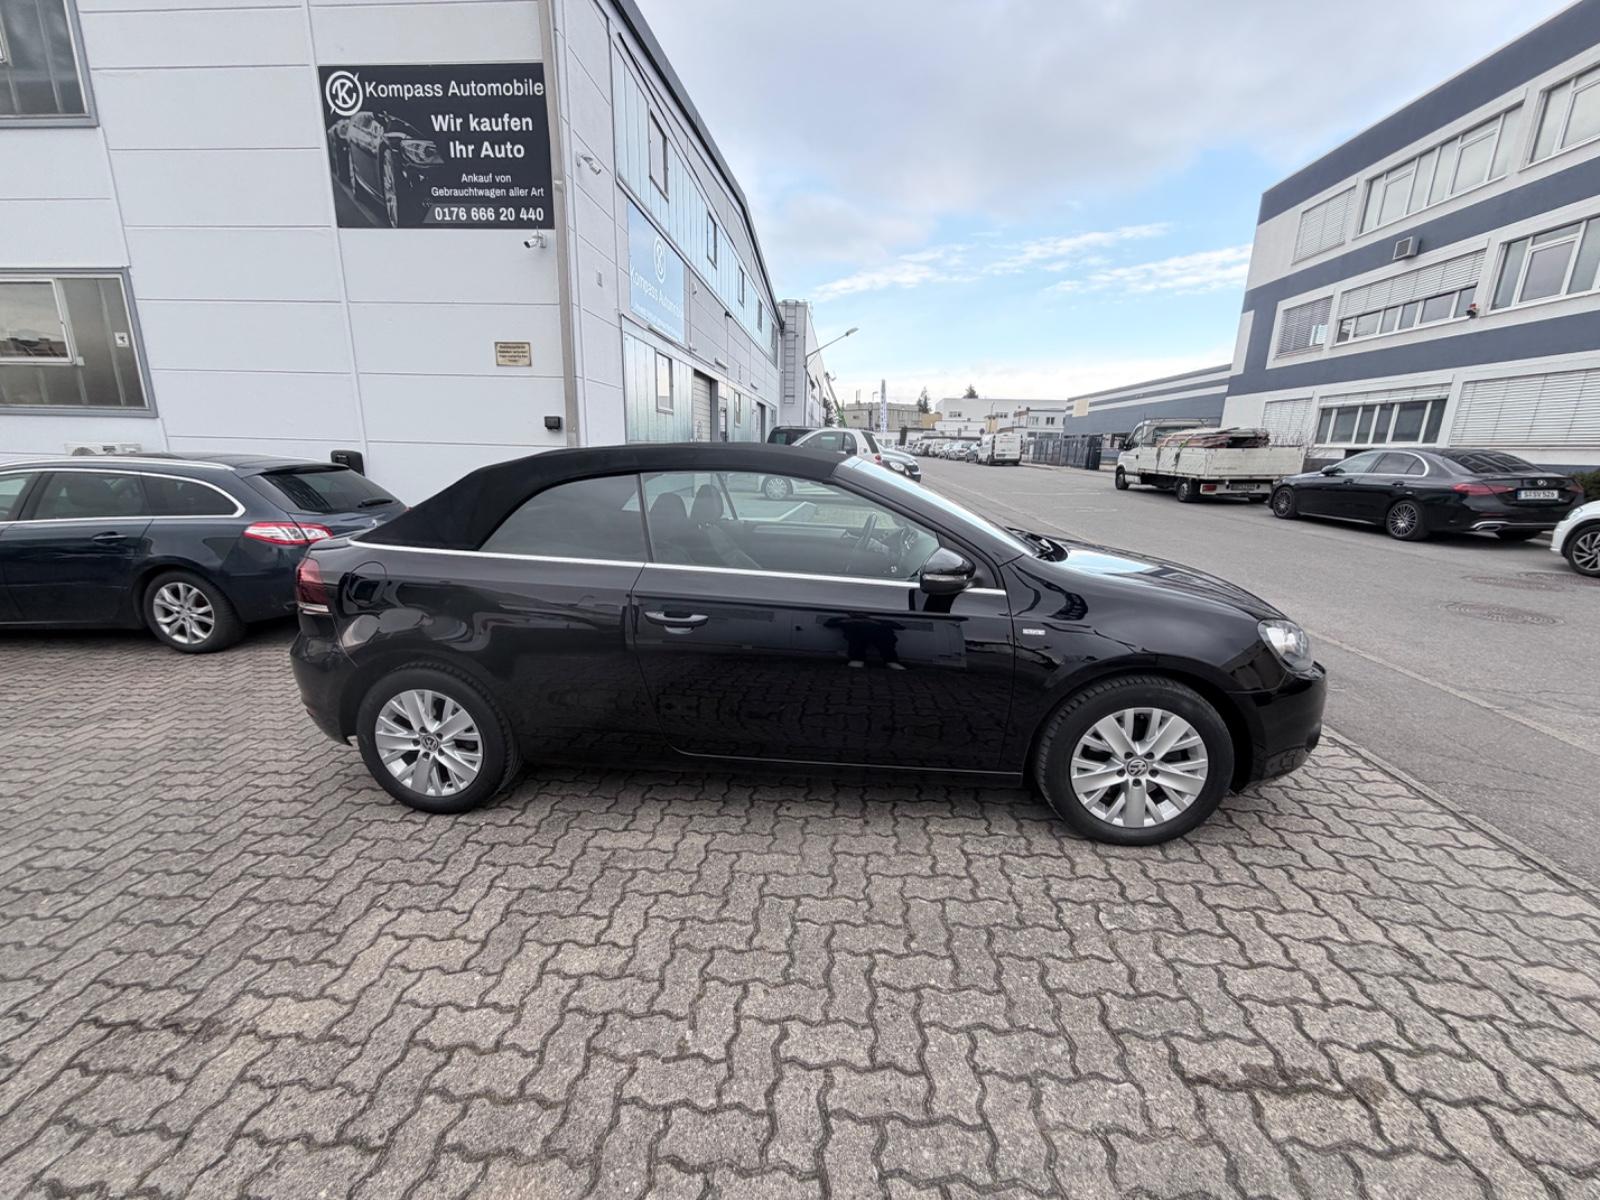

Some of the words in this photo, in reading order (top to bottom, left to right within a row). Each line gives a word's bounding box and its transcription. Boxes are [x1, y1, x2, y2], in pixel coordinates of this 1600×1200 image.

[365, 81, 443, 100] Kompass
[448, 78, 544, 97] Automobile
[431, 114, 463, 132] Wir
[469, 113, 533, 132] kaufen
[449, 141, 474, 158] Ihr
[480, 141, 525, 158] Auto
[461, 173, 493, 183] Ankauf
[495, 175, 512, 183] von
[431, 187, 507, 199] Gebrauchtwagen
[508, 186, 528, 197] aller
[530, 187, 544, 197] Art
[434, 207, 467, 221] 0176
[471, 207, 495, 221] 666
[499, 207, 516, 221] 20
[519, 207, 544, 221] 440
